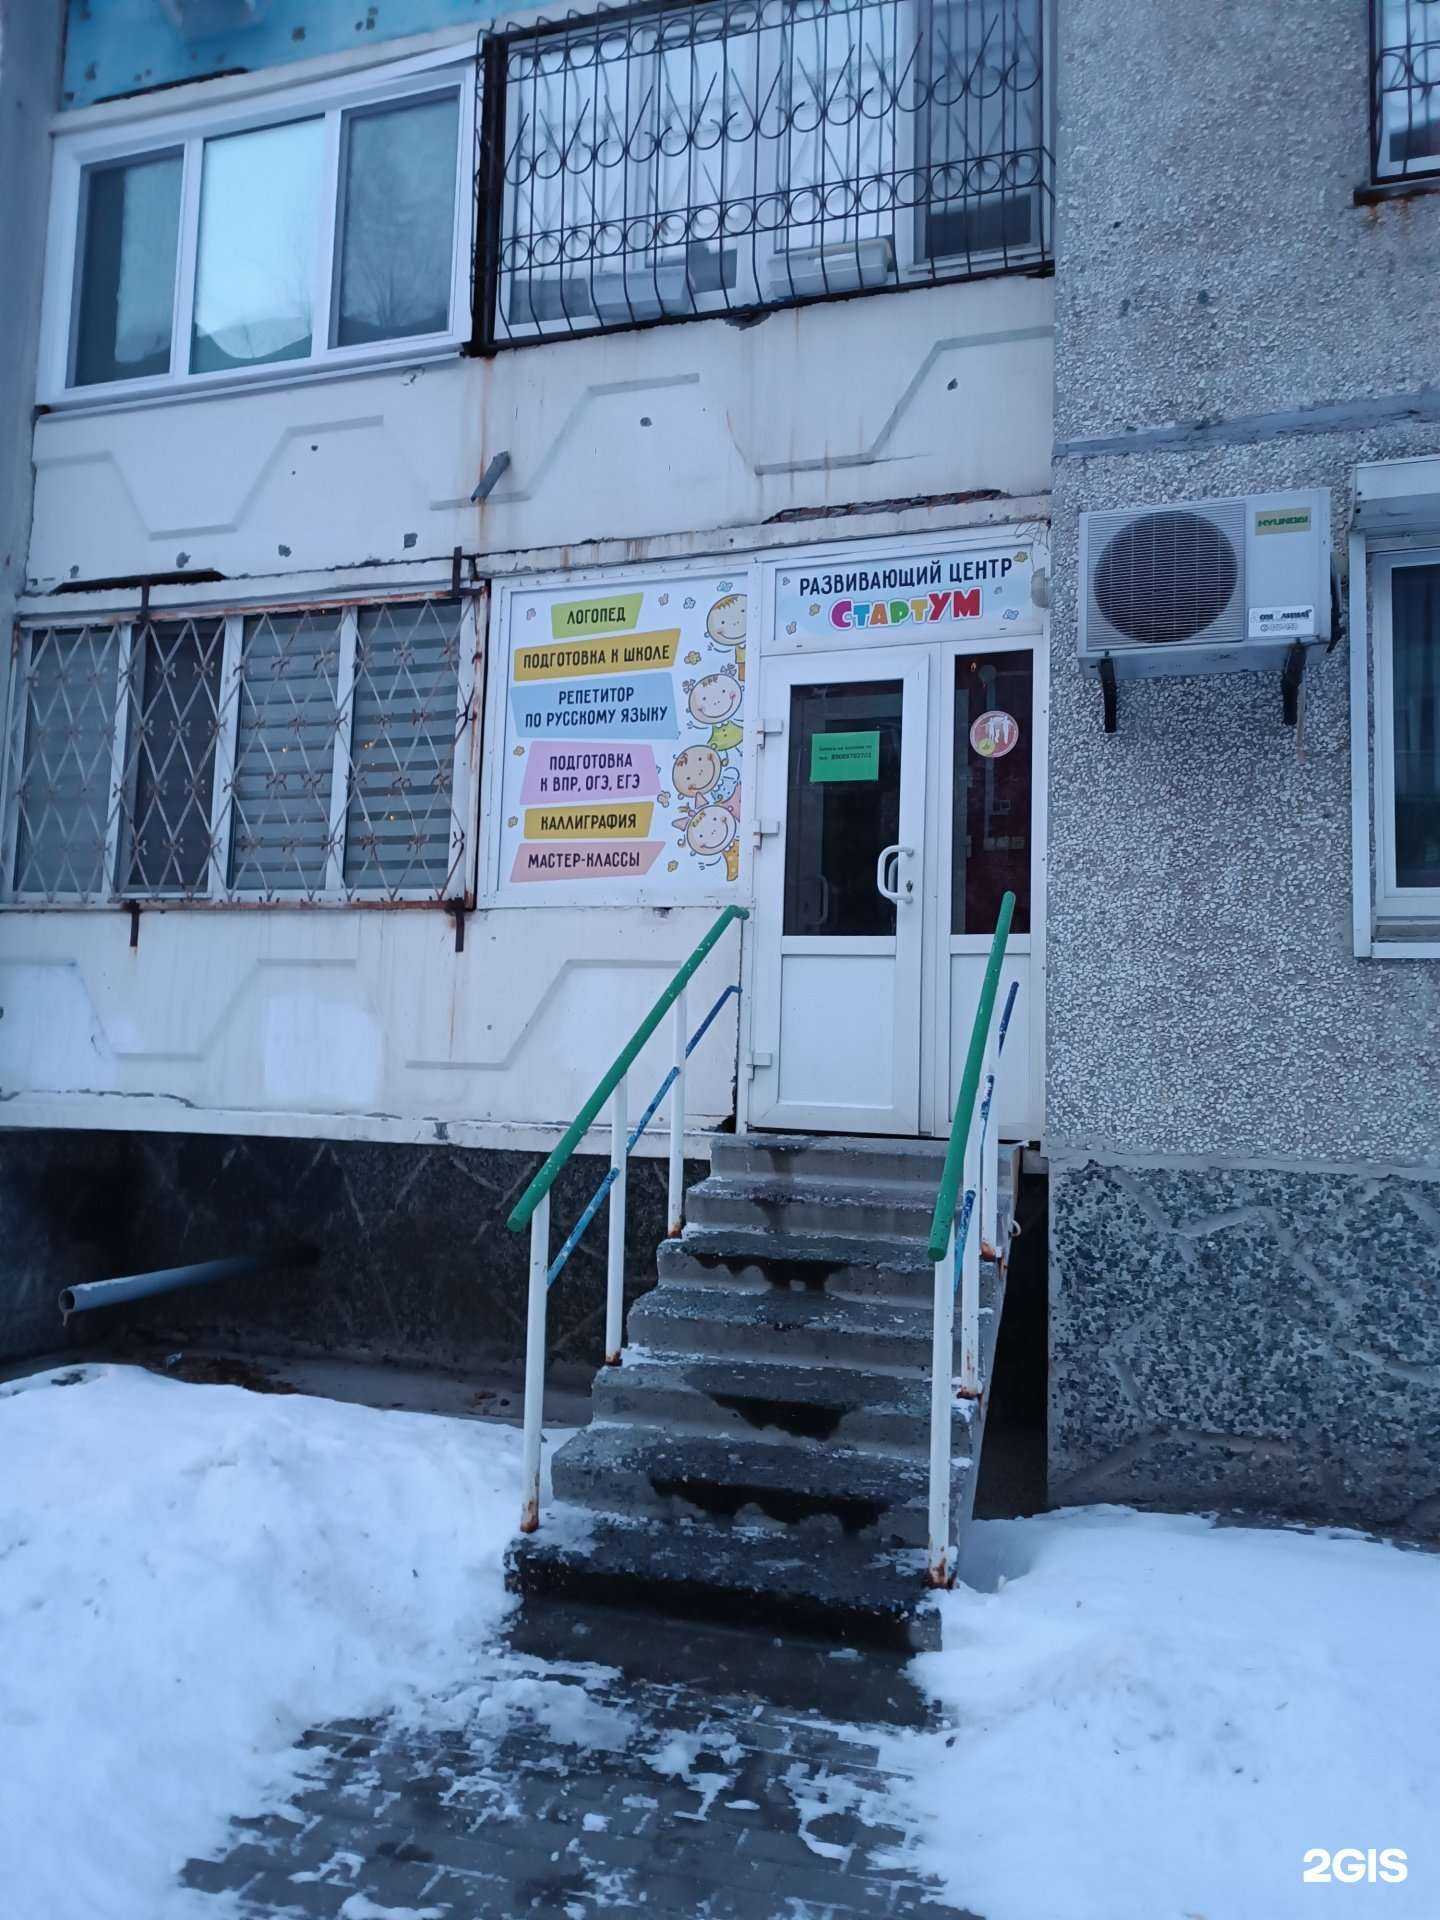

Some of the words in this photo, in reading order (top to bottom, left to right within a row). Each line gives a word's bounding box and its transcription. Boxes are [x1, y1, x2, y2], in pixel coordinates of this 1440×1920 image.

[799, 560, 942, 597] РАЗВИВАЮЩИЙ
[949, 557, 1012, 583] ЦЕНТР
[566, 606, 626, 625] ЛОГОПЕД
[523, 649, 606, 669] ПОДГОТОВКА
[611, 649, 619, 662] К
[624, 644, 670, 663] ШКОЛЕ
[558, 686, 634, 705] РЕПЕТИТОР
[525, 713, 541, 728] ПО
[546, 709, 616, 727] РУССКОМУ
[620, 706, 668, 724] ЯЗЫКУ
[549, 753, 633, 771] ПОДГОТОВКА
[540, 780, 548, 792] К
[553, 777, 581, 793] ВПР,
[585, 775, 612, 792] ОГЭ,
[616, 774, 640, 789] ЕГЭ
[540, 813, 637, 831] КАЛЛИГРАФИЯ
[528, 852, 640, 869] МАСТЕР-КЛАССЫ
